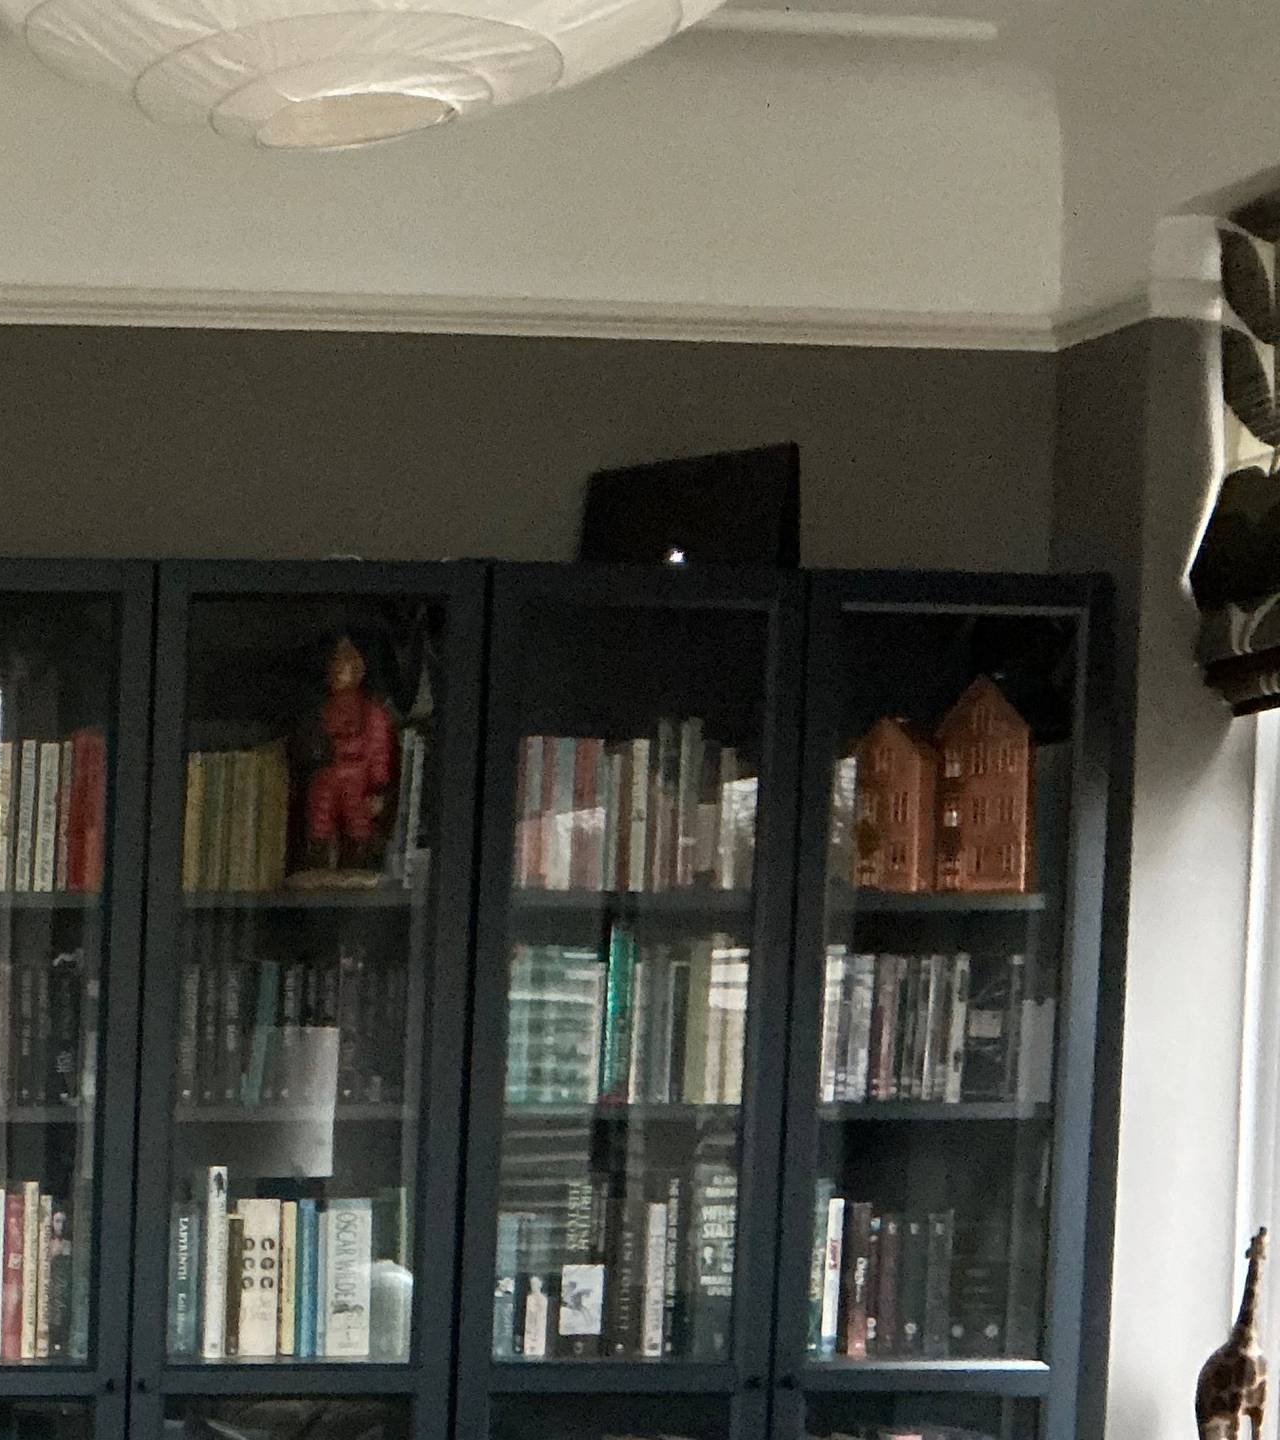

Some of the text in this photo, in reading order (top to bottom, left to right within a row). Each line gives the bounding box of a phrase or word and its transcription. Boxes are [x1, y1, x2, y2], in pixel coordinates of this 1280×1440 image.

[178, 1218, 188, 1280] LABYRINTH
[336, 1212, 358, 1256] OSCAR
[334, 1259, 354, 1299] WILDE
